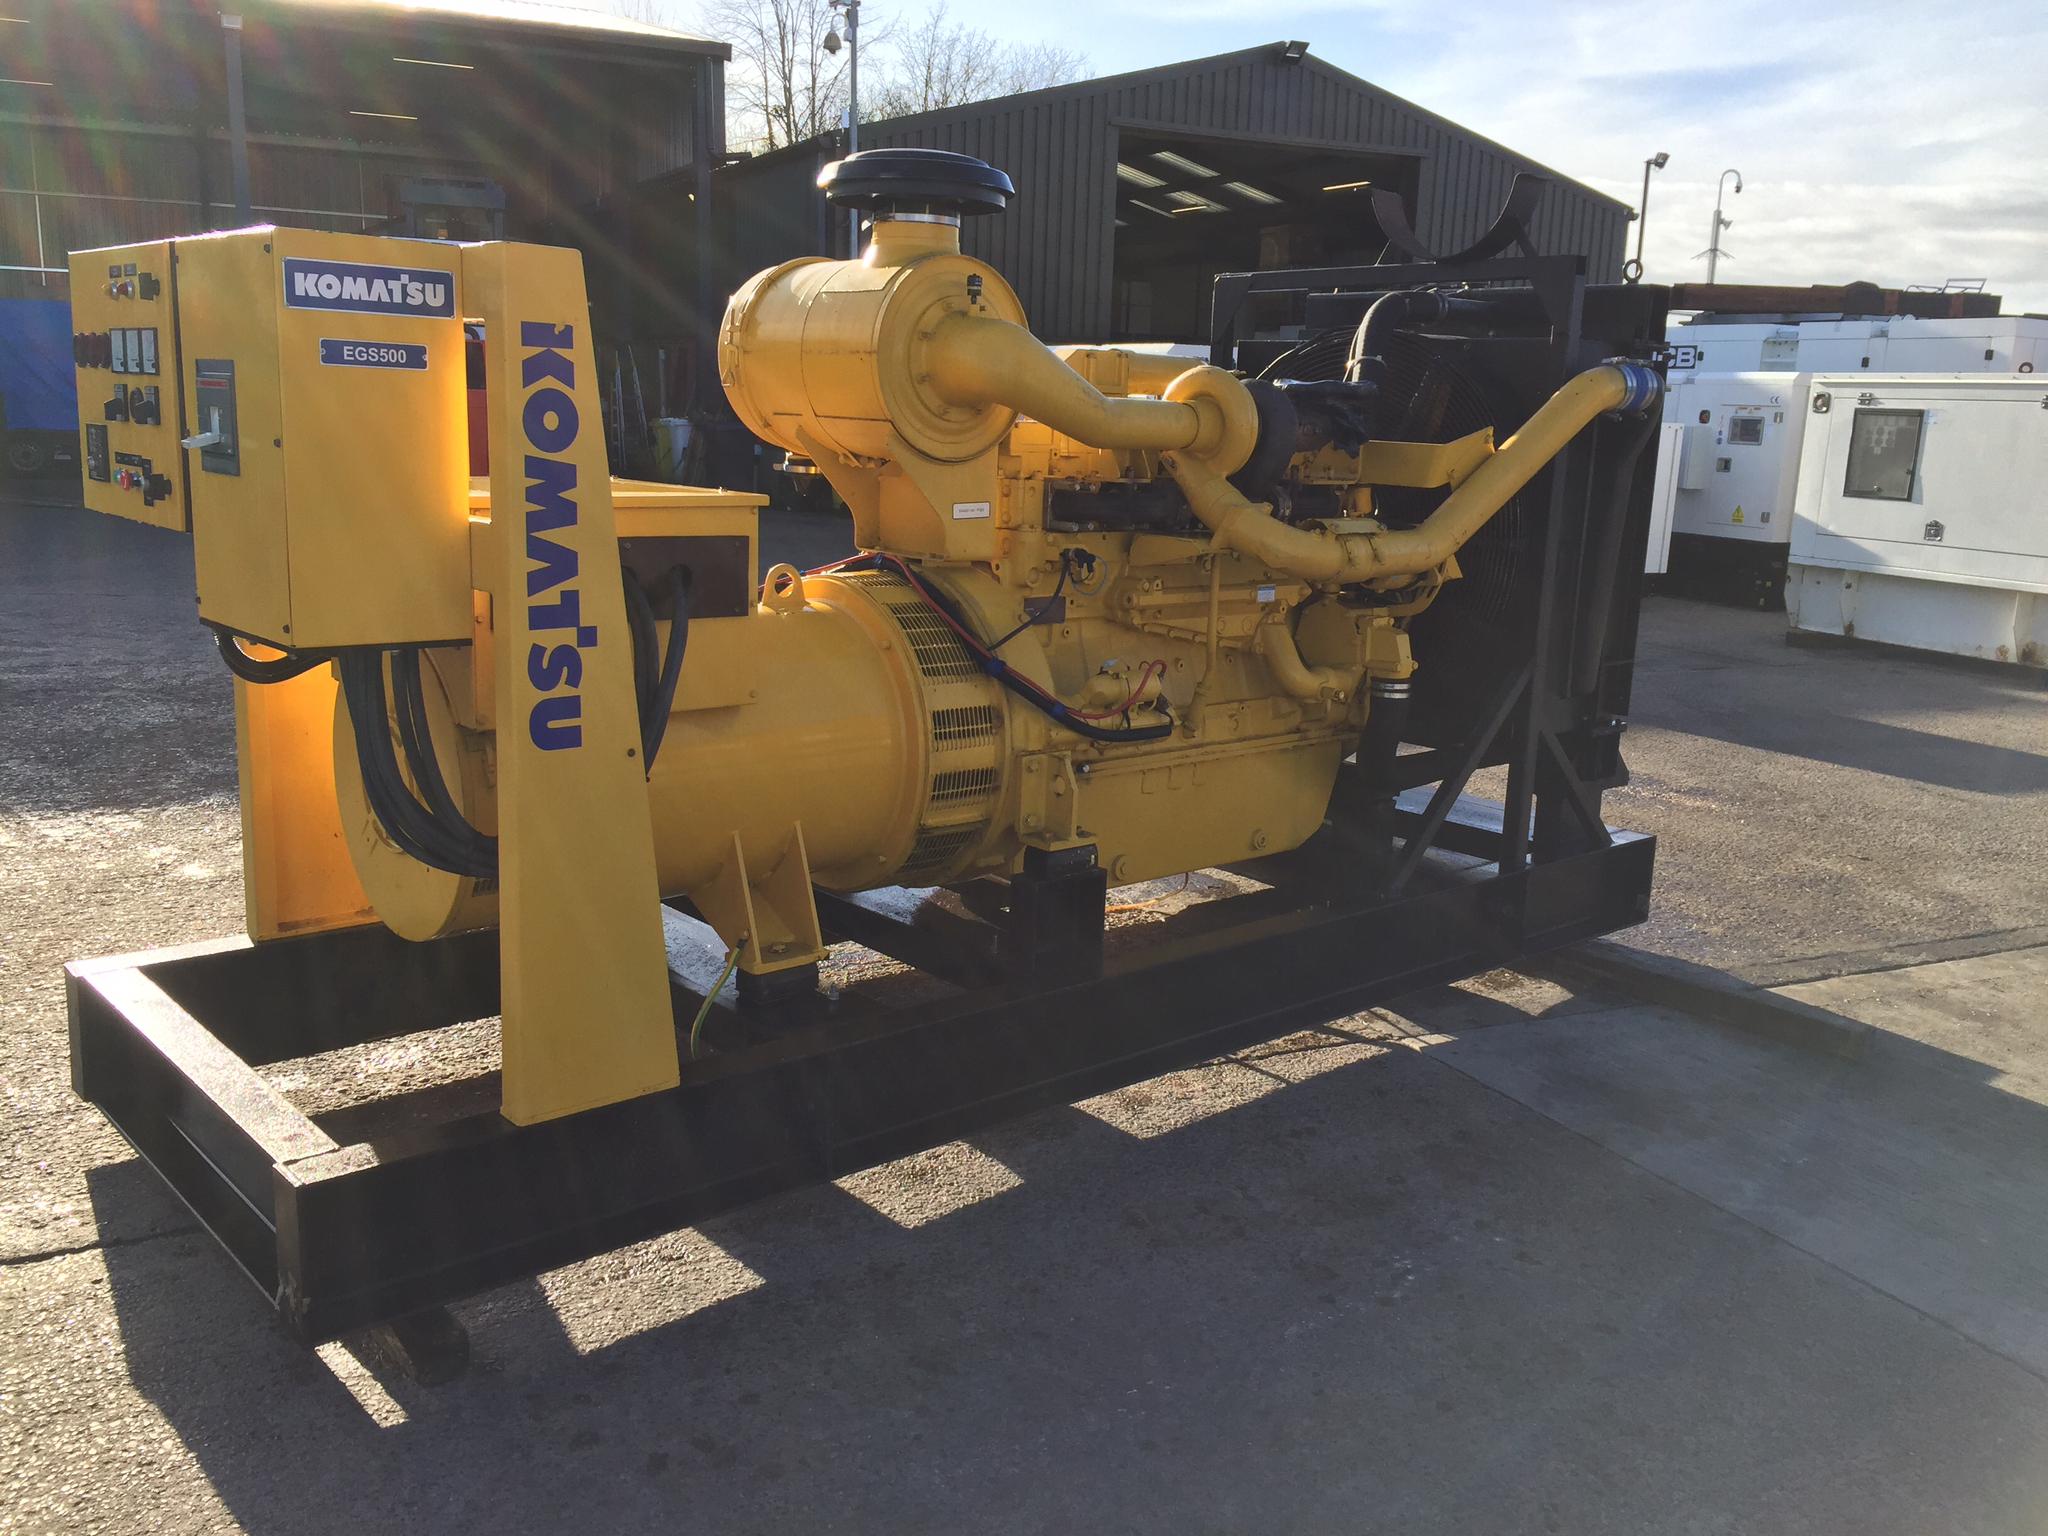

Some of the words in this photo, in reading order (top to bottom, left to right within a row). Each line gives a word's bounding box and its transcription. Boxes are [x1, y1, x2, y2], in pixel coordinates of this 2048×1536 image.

[294, 272, 445, 307] KOMATSU
[343, 346, 407, 363] EGS500
[521, 321, 598, 751] KOMATSU
